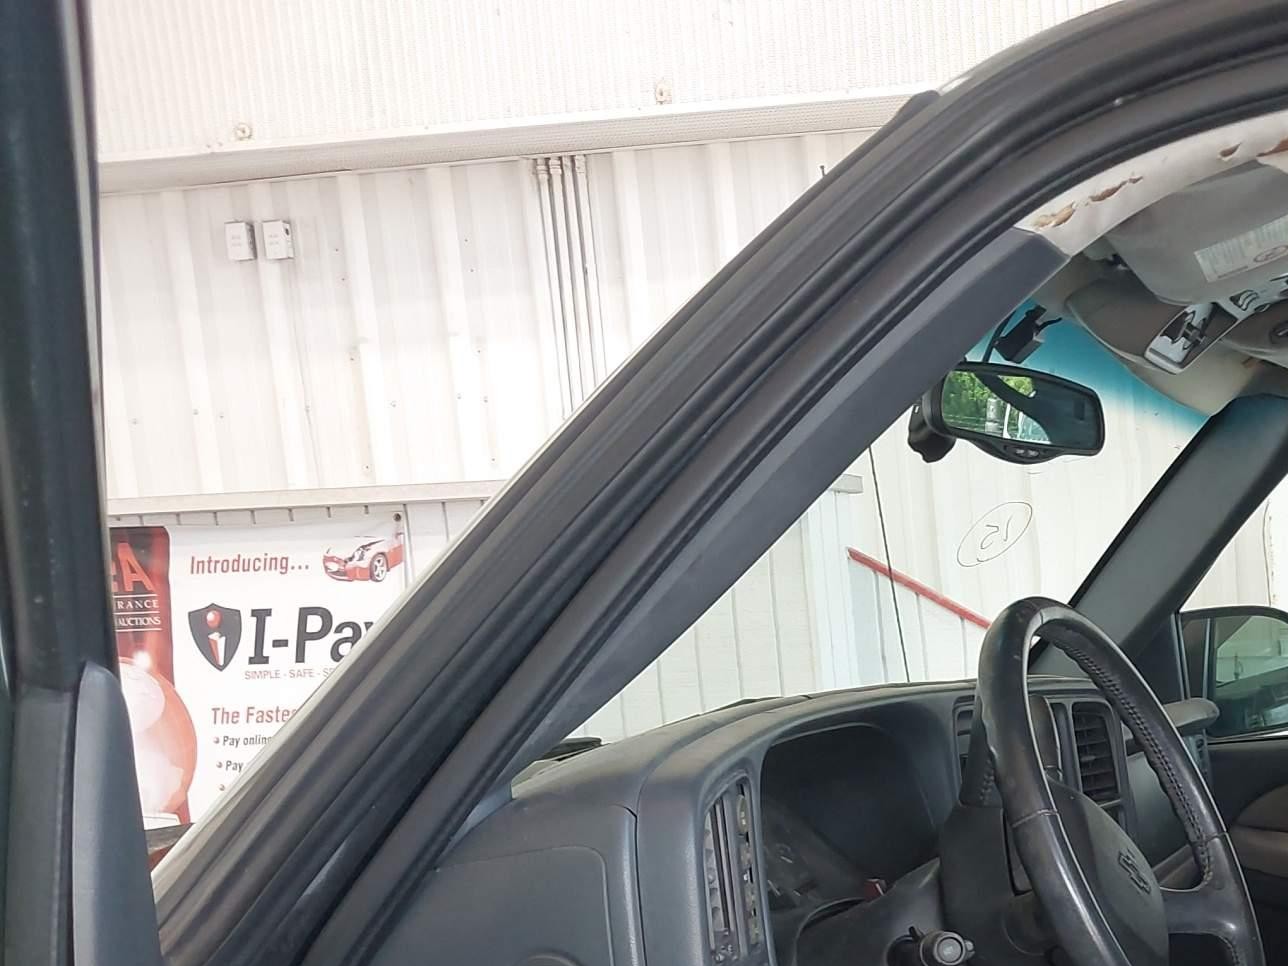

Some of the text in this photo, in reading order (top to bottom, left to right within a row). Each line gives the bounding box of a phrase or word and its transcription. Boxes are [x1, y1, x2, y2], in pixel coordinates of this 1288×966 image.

[189, 552, 309, 575] Introducing...
[248, 606, 374, 665] I-Pa
[244, 669, 281, 680] SIMPLE
[288, 668, 315, 679] SAFE
[211, 706, 241, 725] The
[222, 734, 241, 749] Pay
[225, 760, 244, 773] Pay
